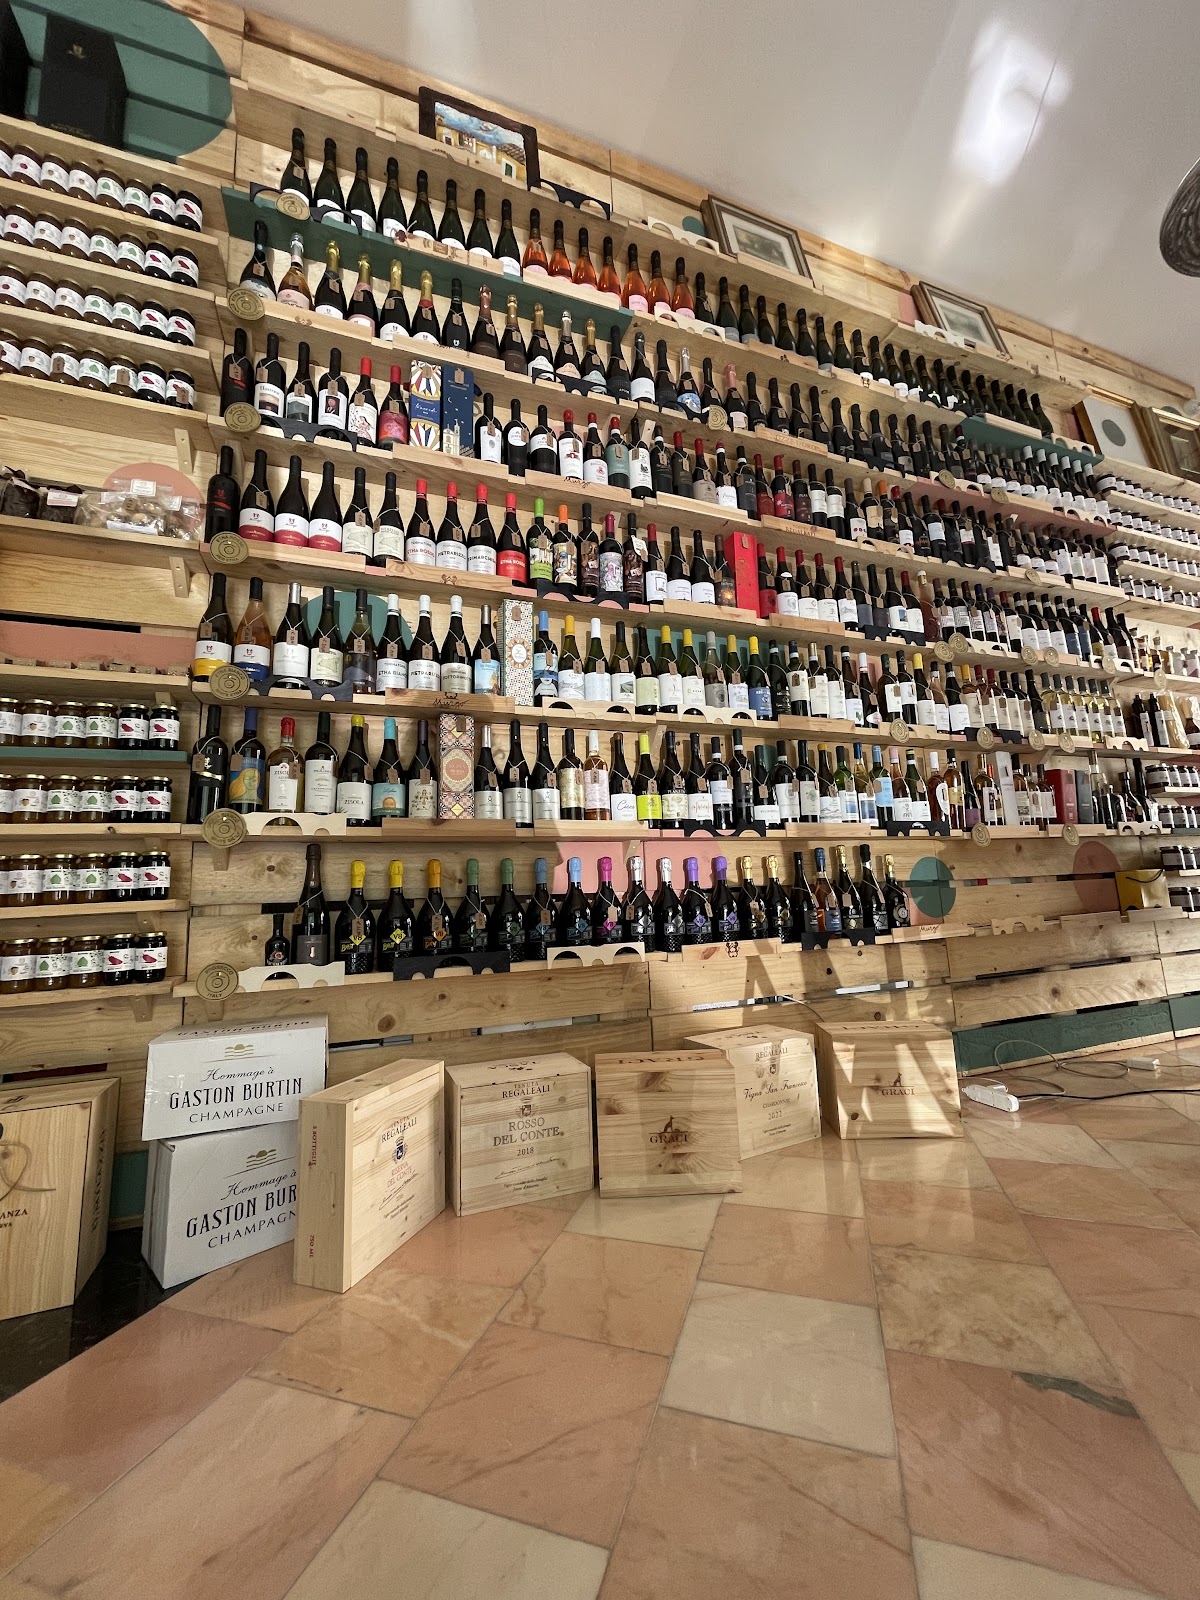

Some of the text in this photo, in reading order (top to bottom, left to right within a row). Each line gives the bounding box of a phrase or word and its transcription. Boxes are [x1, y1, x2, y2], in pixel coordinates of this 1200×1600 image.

[205, 965, 235, 976] PROSECCO
[755, 1047, 789, 1060] REGALEALI
[201, 1066, 275, 1083] Hommage à
[169, 1077, 302, 1110] GASTON BURTIN
[502, 1084, 551, 1098] REGALEALI
[765, 1083, 778, 1096] San
[780, 1079, 808, 1092] Francesco
[881, 1088, 915, 1096] GRACI
[189, 1102, 284, 1124] CHAMPAGNE
[768, 1110, 783, 1121] 2022
[381, 1117, 418, 1143] REGALEALI
[508, 1117, 546, 1132] ROSSO
[493, 1126, 561, 1147] DEL CONTE
[650, 1133, 689, 1144] GRACI
[516, 1146, 535, 1157] 2018
[220, 1169, 297, 1201] Hommage à
[186, 1184, 297, 1238] GASTON BUR
[208, 1210, 297, 1249] CHAMPAGN
